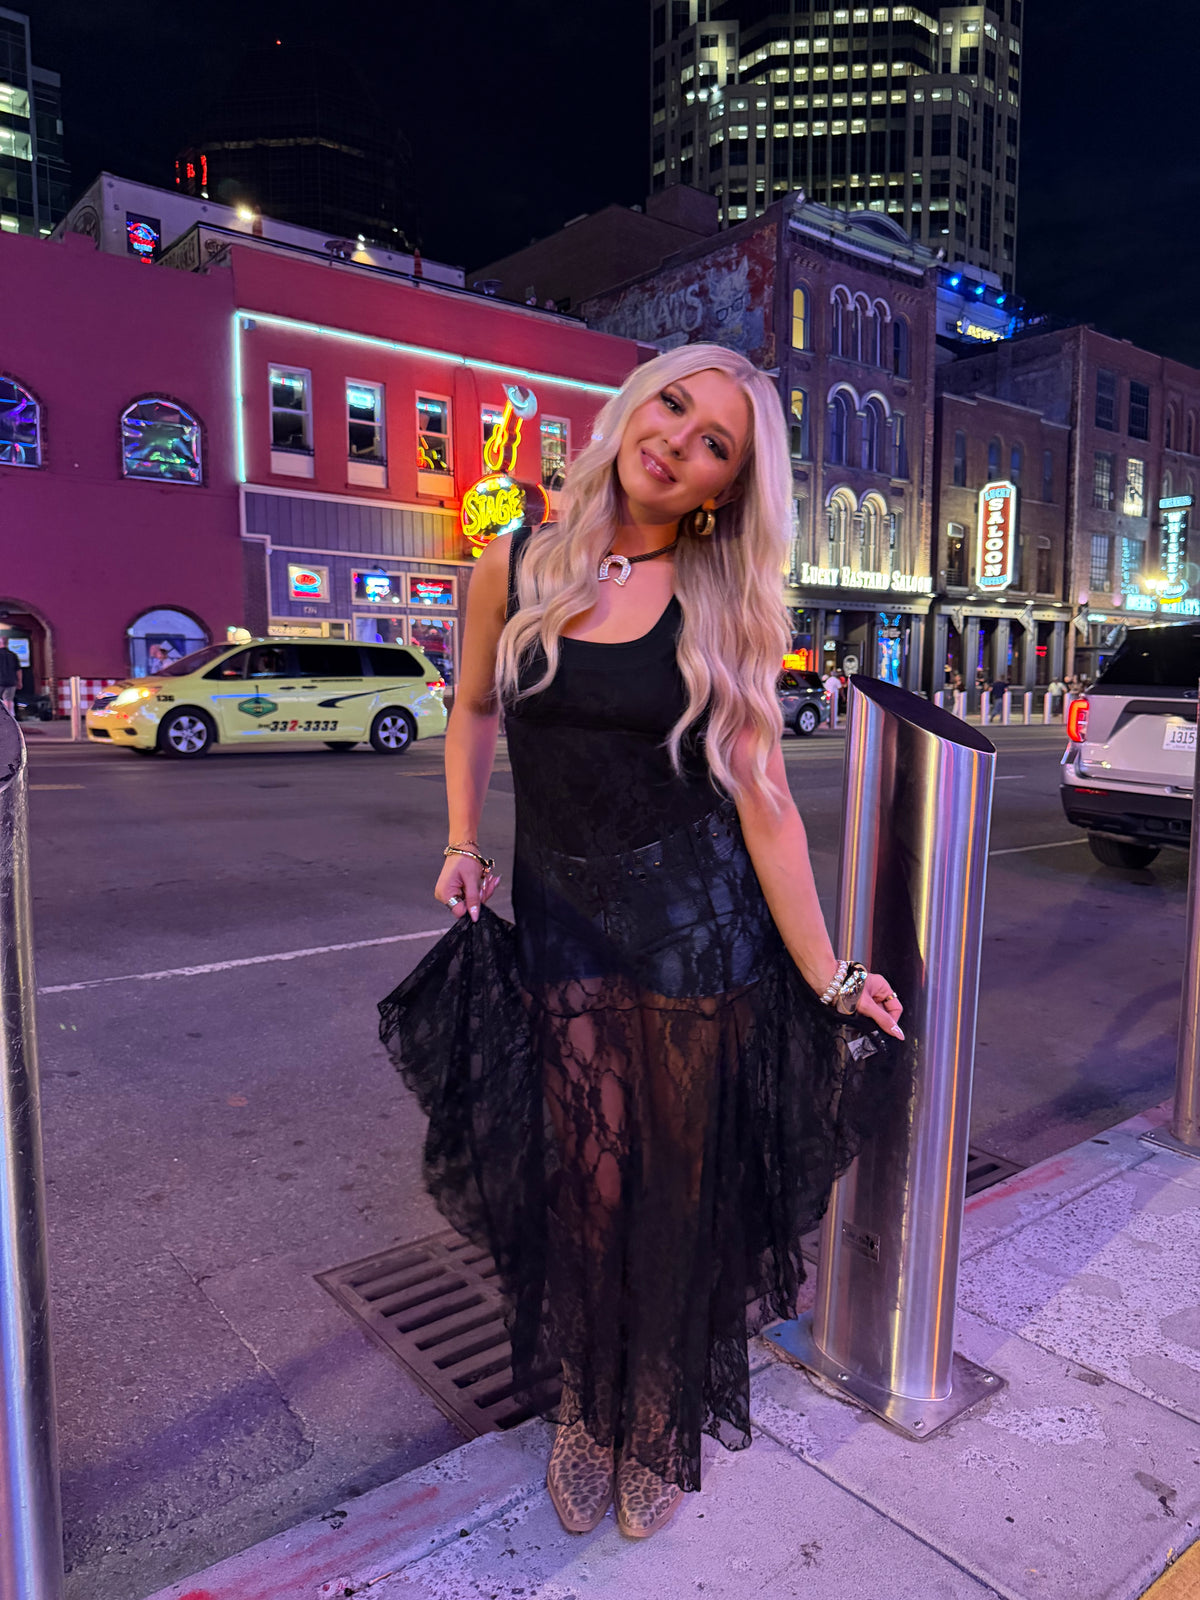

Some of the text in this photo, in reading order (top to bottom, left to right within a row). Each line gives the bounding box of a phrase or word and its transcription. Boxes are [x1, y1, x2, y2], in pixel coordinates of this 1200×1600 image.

[463, 488, 523, 536] STAGE
[984, 498, 1005, 577] SALOON
[1166, 511, 1182, 584] WHISKEY
[841, 566, 891, 590] BASTARD
[891, 570, 932, 593] SALOON
[270, 720, 339, 732] 332-3333
